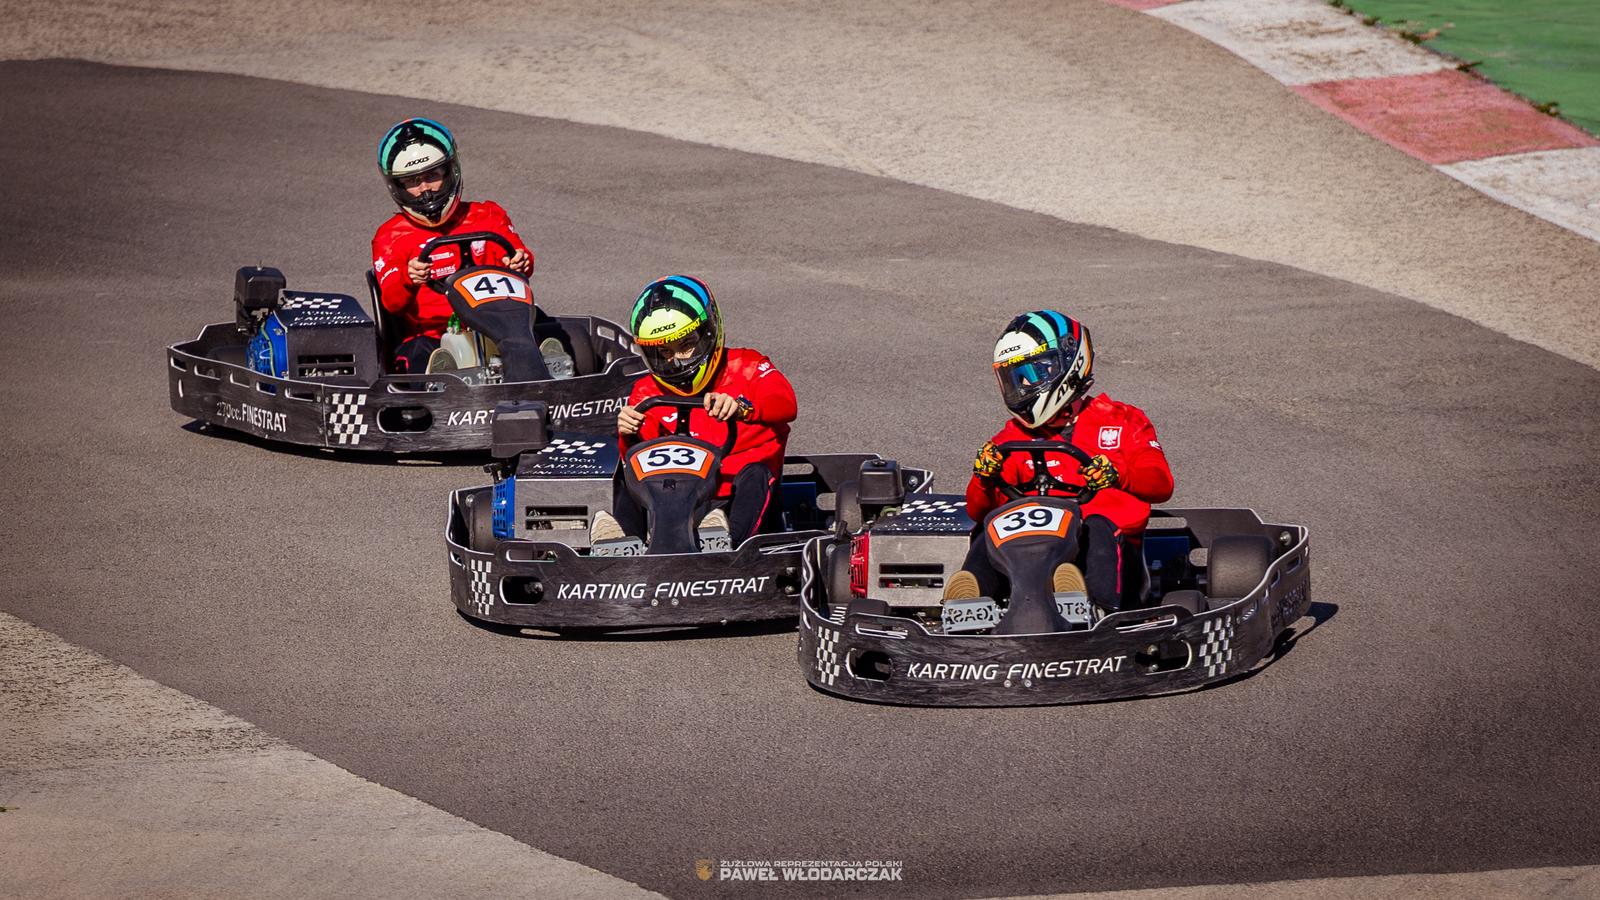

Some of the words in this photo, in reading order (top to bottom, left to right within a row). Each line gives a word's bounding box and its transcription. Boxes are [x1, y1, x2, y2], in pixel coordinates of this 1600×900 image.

[404, 156, 430, 168] AXXIS
[474, 277, 516, 294] 41
[650, 322, 676, 335] AXXIS
[242, 403, 287, 432] FINESTRAT
[447, 409, 494, 426] KART
[647, 448, 696, 467] 53
[1002, 508, 1053, 531] 39
[557, 583, 647, 600] KARTING
[655, 576, 769, 598] FINESTRAT
[907, 662, 999, 680] KARTING
[1007, 656, 1127, 680] FINESTRAT
